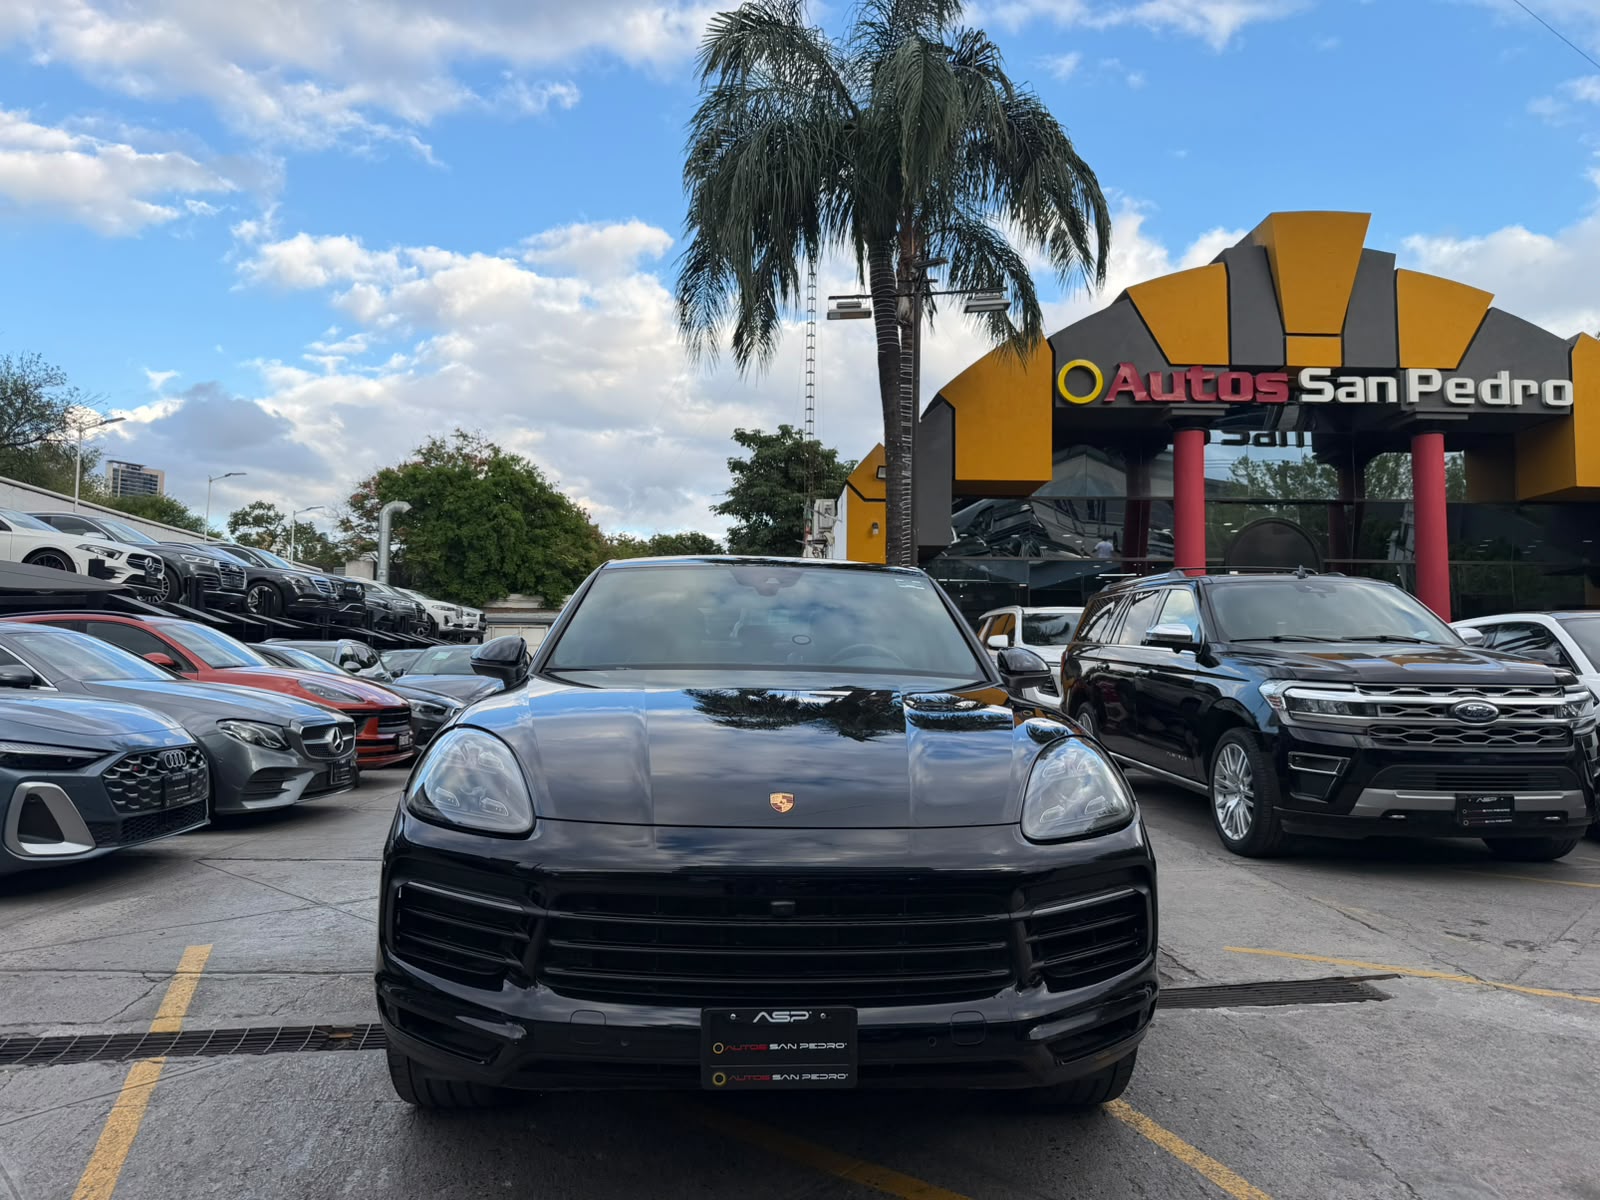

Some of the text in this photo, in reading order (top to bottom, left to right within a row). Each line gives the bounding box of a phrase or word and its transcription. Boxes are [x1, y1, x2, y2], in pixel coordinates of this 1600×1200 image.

[1103, 362, 1574, 407] Autos San Pedro
[753, 1011, 811, 1023] ASP
[799, 1042, 846, 1050] PEDRO
